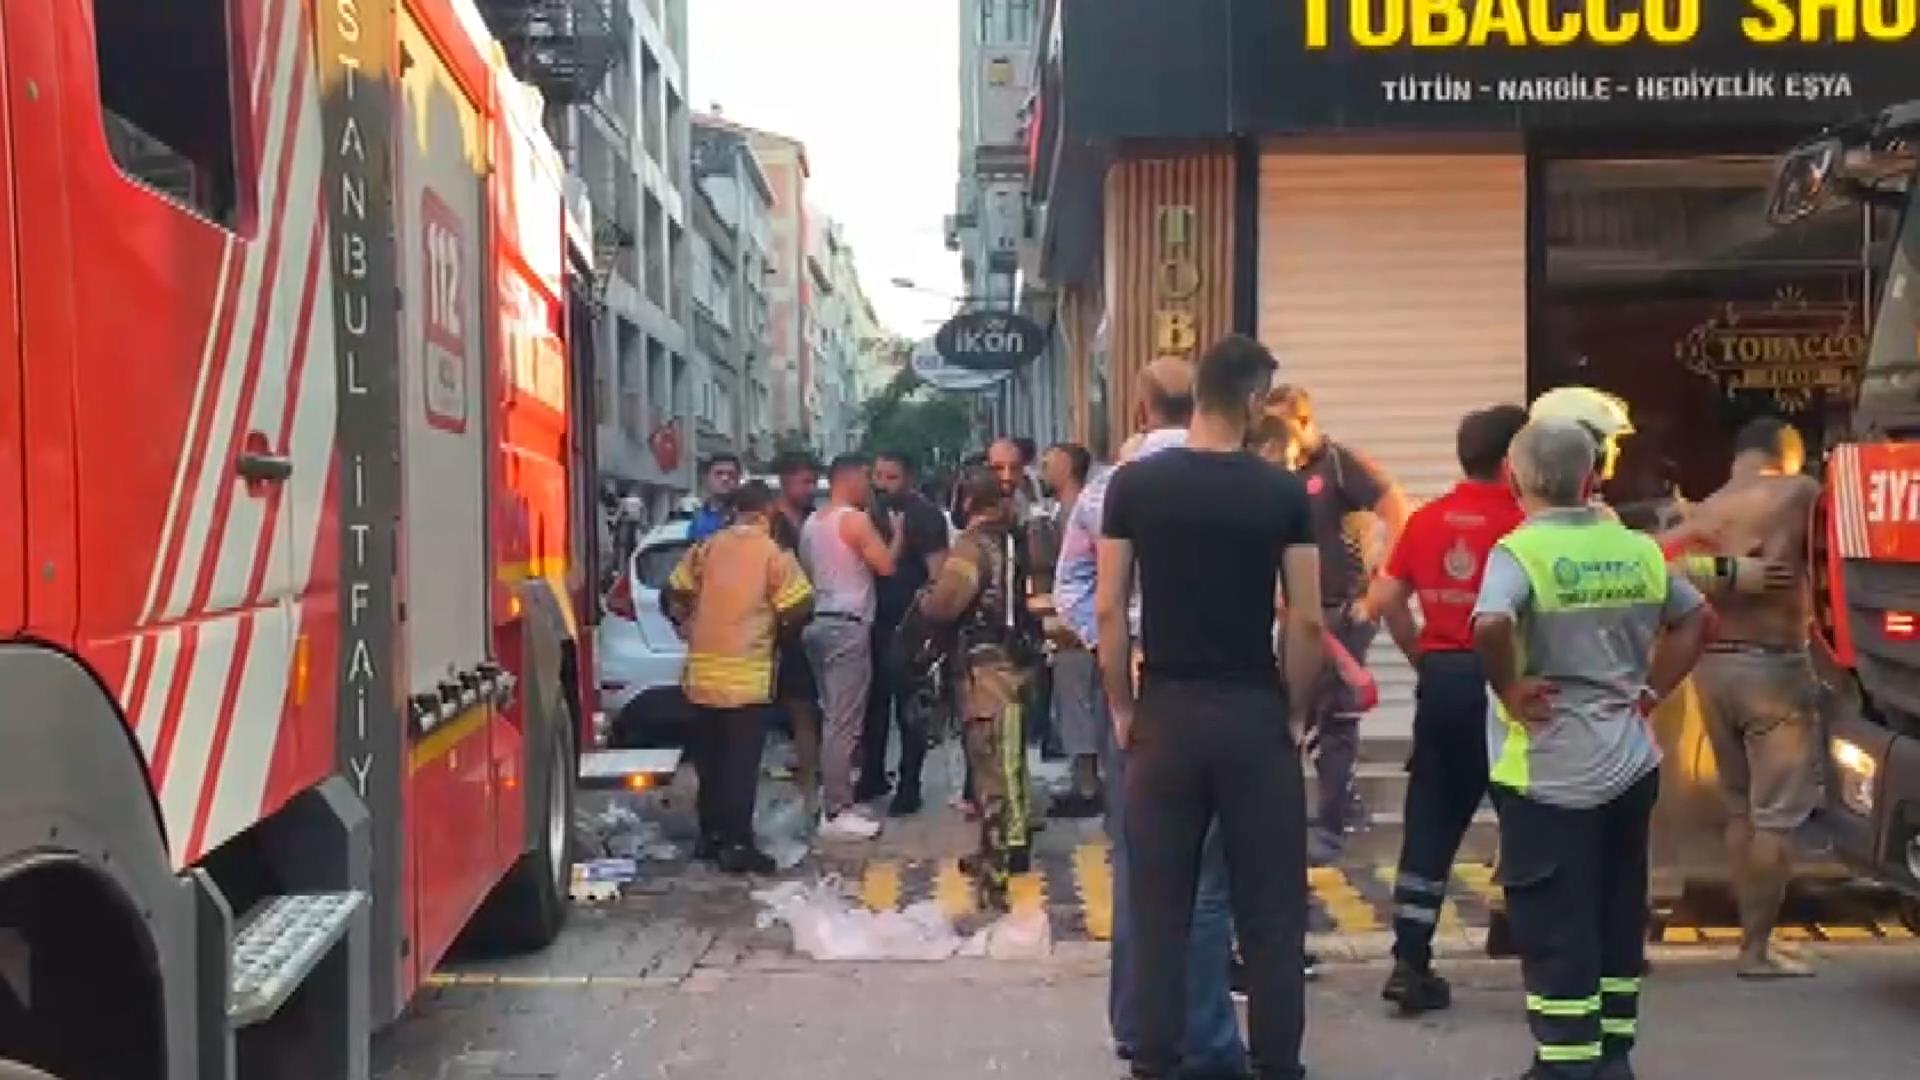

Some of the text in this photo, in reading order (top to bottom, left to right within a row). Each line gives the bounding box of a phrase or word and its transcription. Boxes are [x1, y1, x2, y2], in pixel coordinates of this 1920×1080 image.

[1381, 74, 1471, 101] TÜTÜN
[1785, 69, 1853, 99] EŞYA
[428, 222, 461, 335] 112
